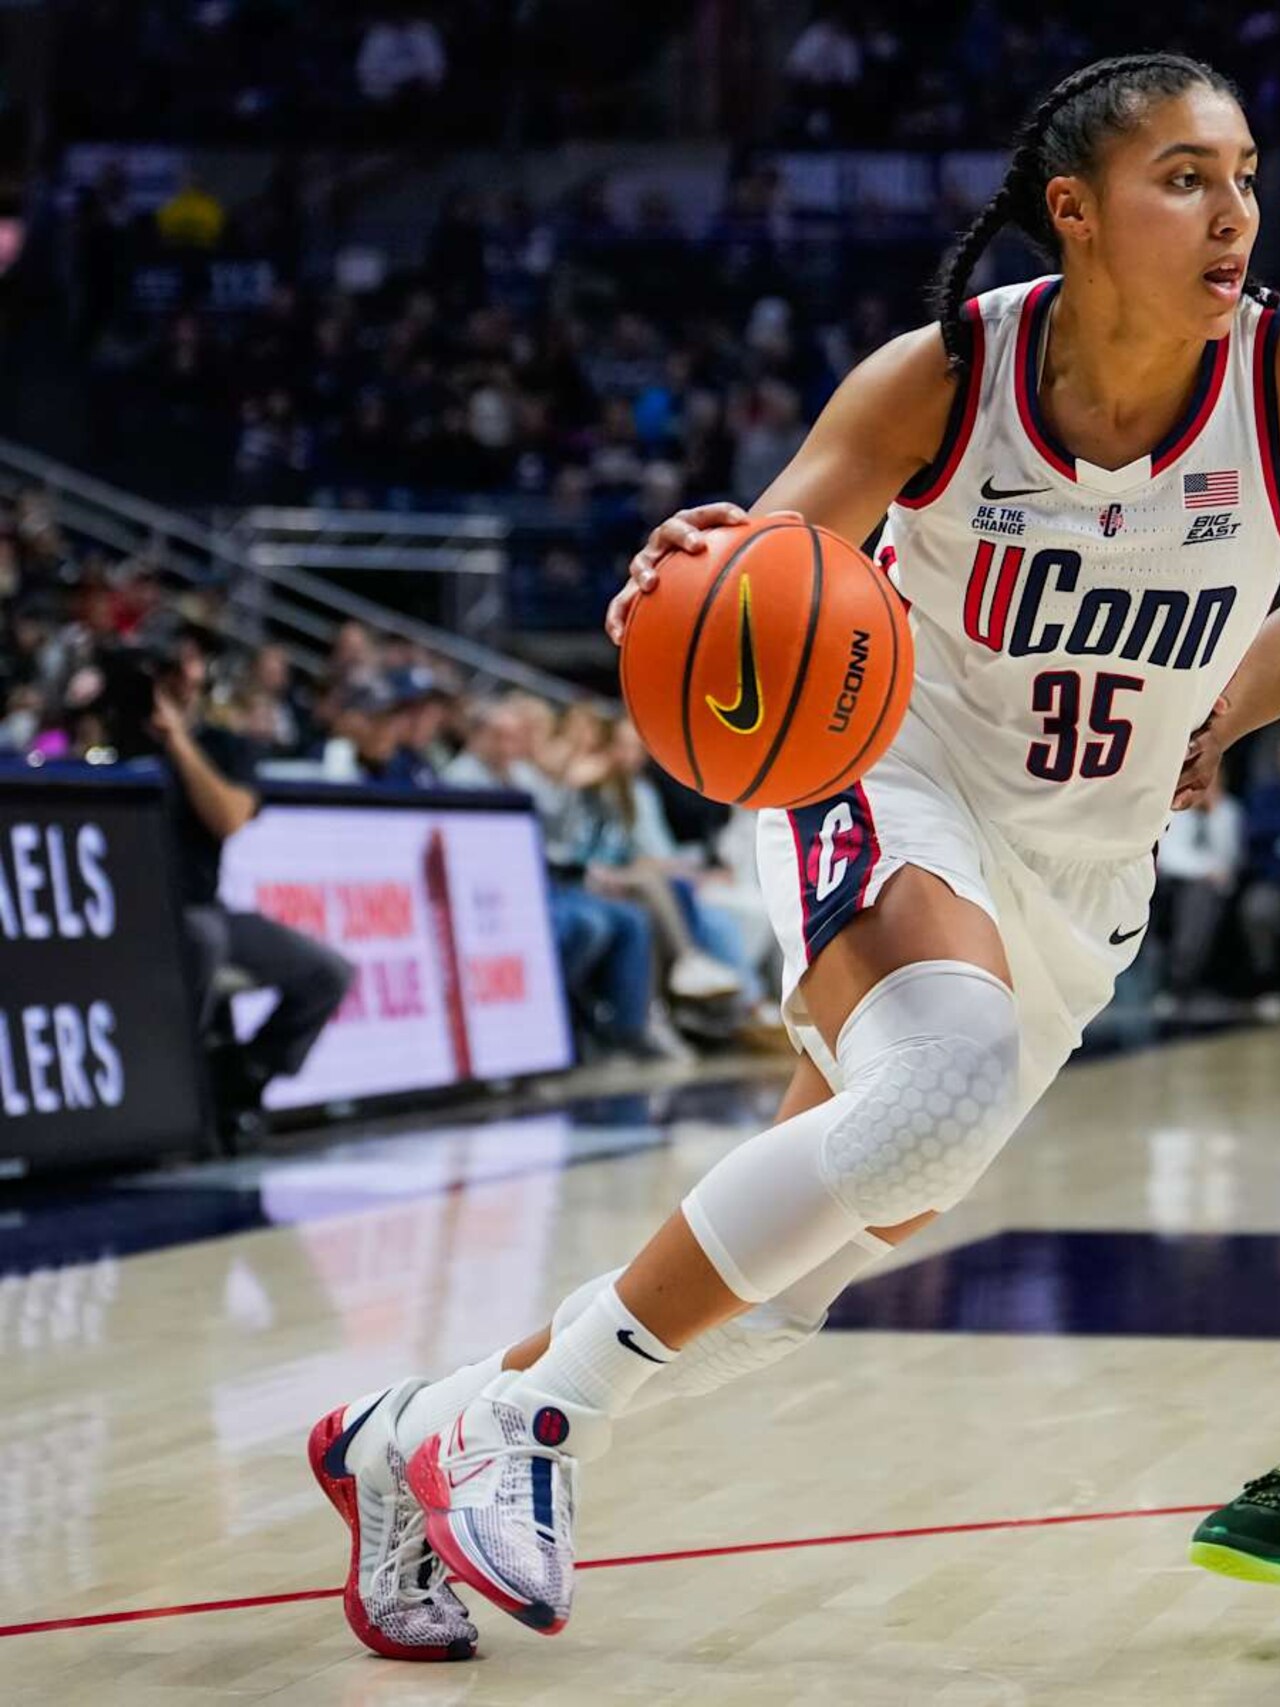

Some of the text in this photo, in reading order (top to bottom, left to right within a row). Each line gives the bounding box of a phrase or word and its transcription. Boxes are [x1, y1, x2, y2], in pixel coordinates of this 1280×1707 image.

[977, 505, 1026, 522] BE THE
[1193, 512, 1232, 527] BIG
[971, 518, 1027, 536] CHANGE
[1186, 523, 1241, 539] EAST
[828, 629, 870, 733] UCONN
[1026, 669, 1146, 783] 35
